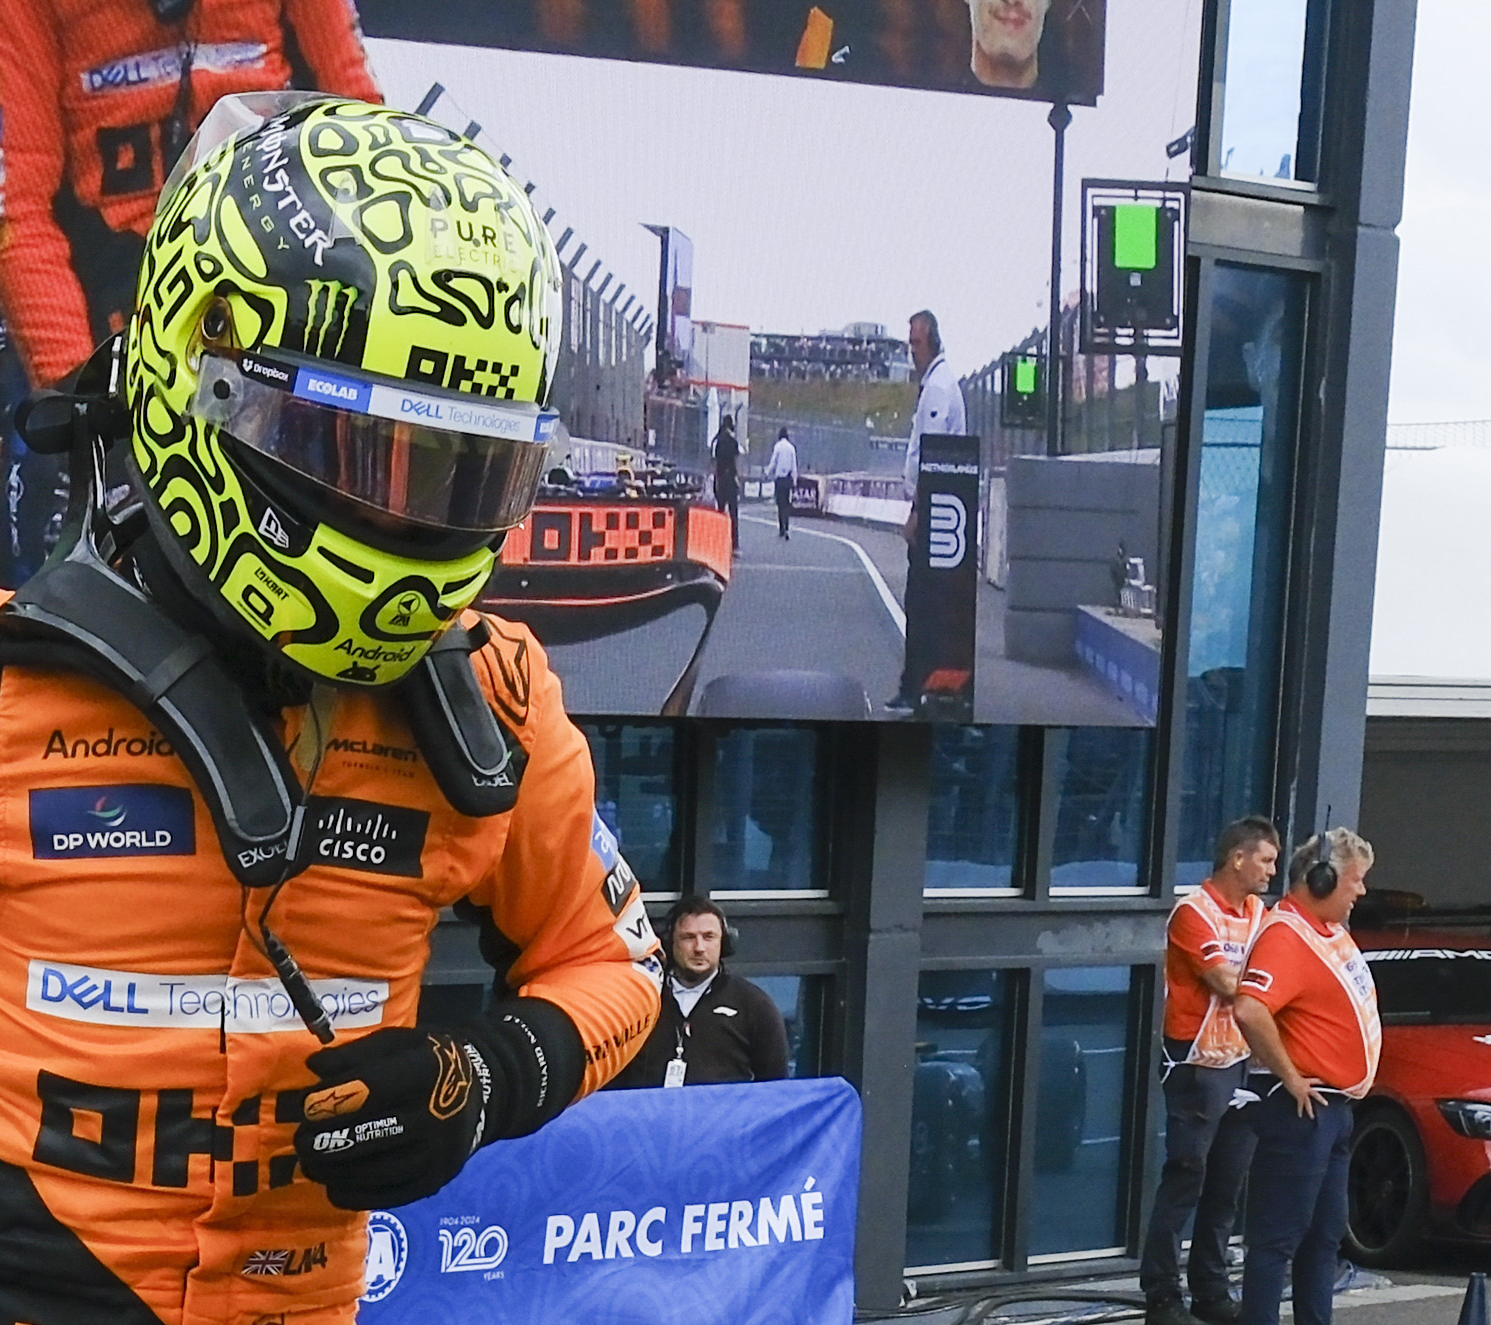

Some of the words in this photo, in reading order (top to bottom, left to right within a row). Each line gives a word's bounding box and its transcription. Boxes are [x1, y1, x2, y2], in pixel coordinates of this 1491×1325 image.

[307, 379, 360, 400] ECOLAB
[400, 397, 444, 420] DELL
[334, 638, 416, 663] Android
[53, 833, 85, 852] DP
[88, 830, 172, 850] WORLD
[41, 967, 149, 1015] DELL
[542, 1205, 666, 1266] PARC
[679, 1174, 827, 1253] FERMÉ
[439, 1225, 509, 1274] 120
